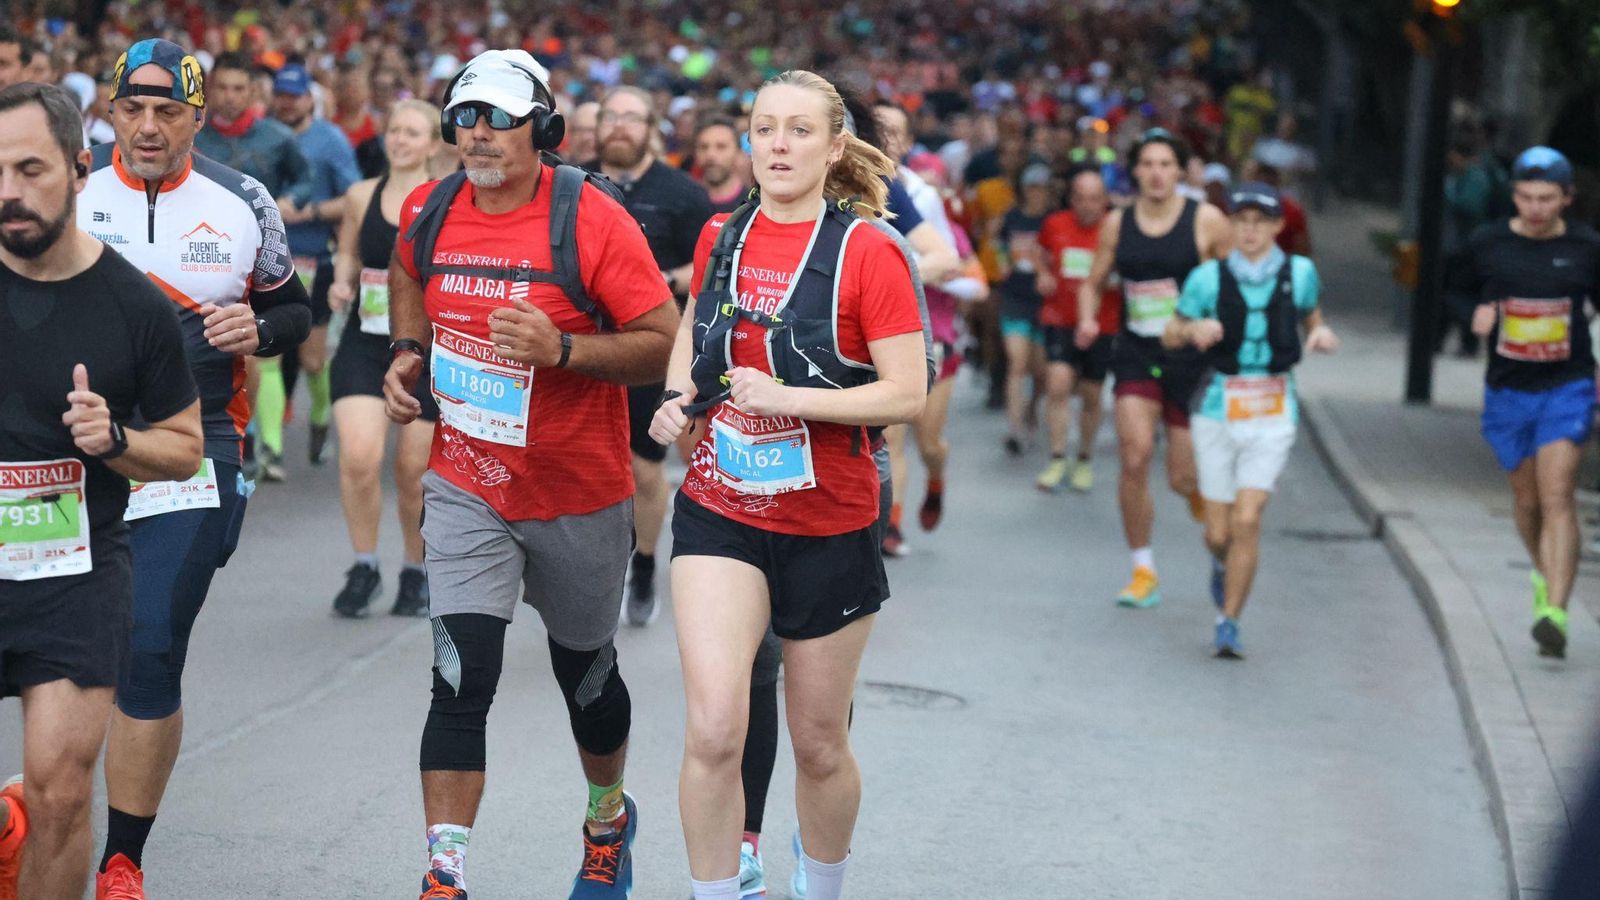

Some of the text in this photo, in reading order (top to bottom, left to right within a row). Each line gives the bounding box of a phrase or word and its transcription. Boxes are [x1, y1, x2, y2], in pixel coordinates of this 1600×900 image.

[189, 242, 219, 253] FUENTE
[181, 253, 189, 262] DEL
[190, 252, 231, 264] ACEBUCHE
[181, 264, 232, 273] CLUB DEPORTIVO
[438, 310, 471, 322] málaga
[448, 366, 505, 399] 11800
[490, 418, 508, 428] 21K
[726, 442, 784, 468] 17162
[0, 464, 73, 486] ENERALI
[180, 485, 200, 493] 21K
[45, 548, 67, 558] 21K
